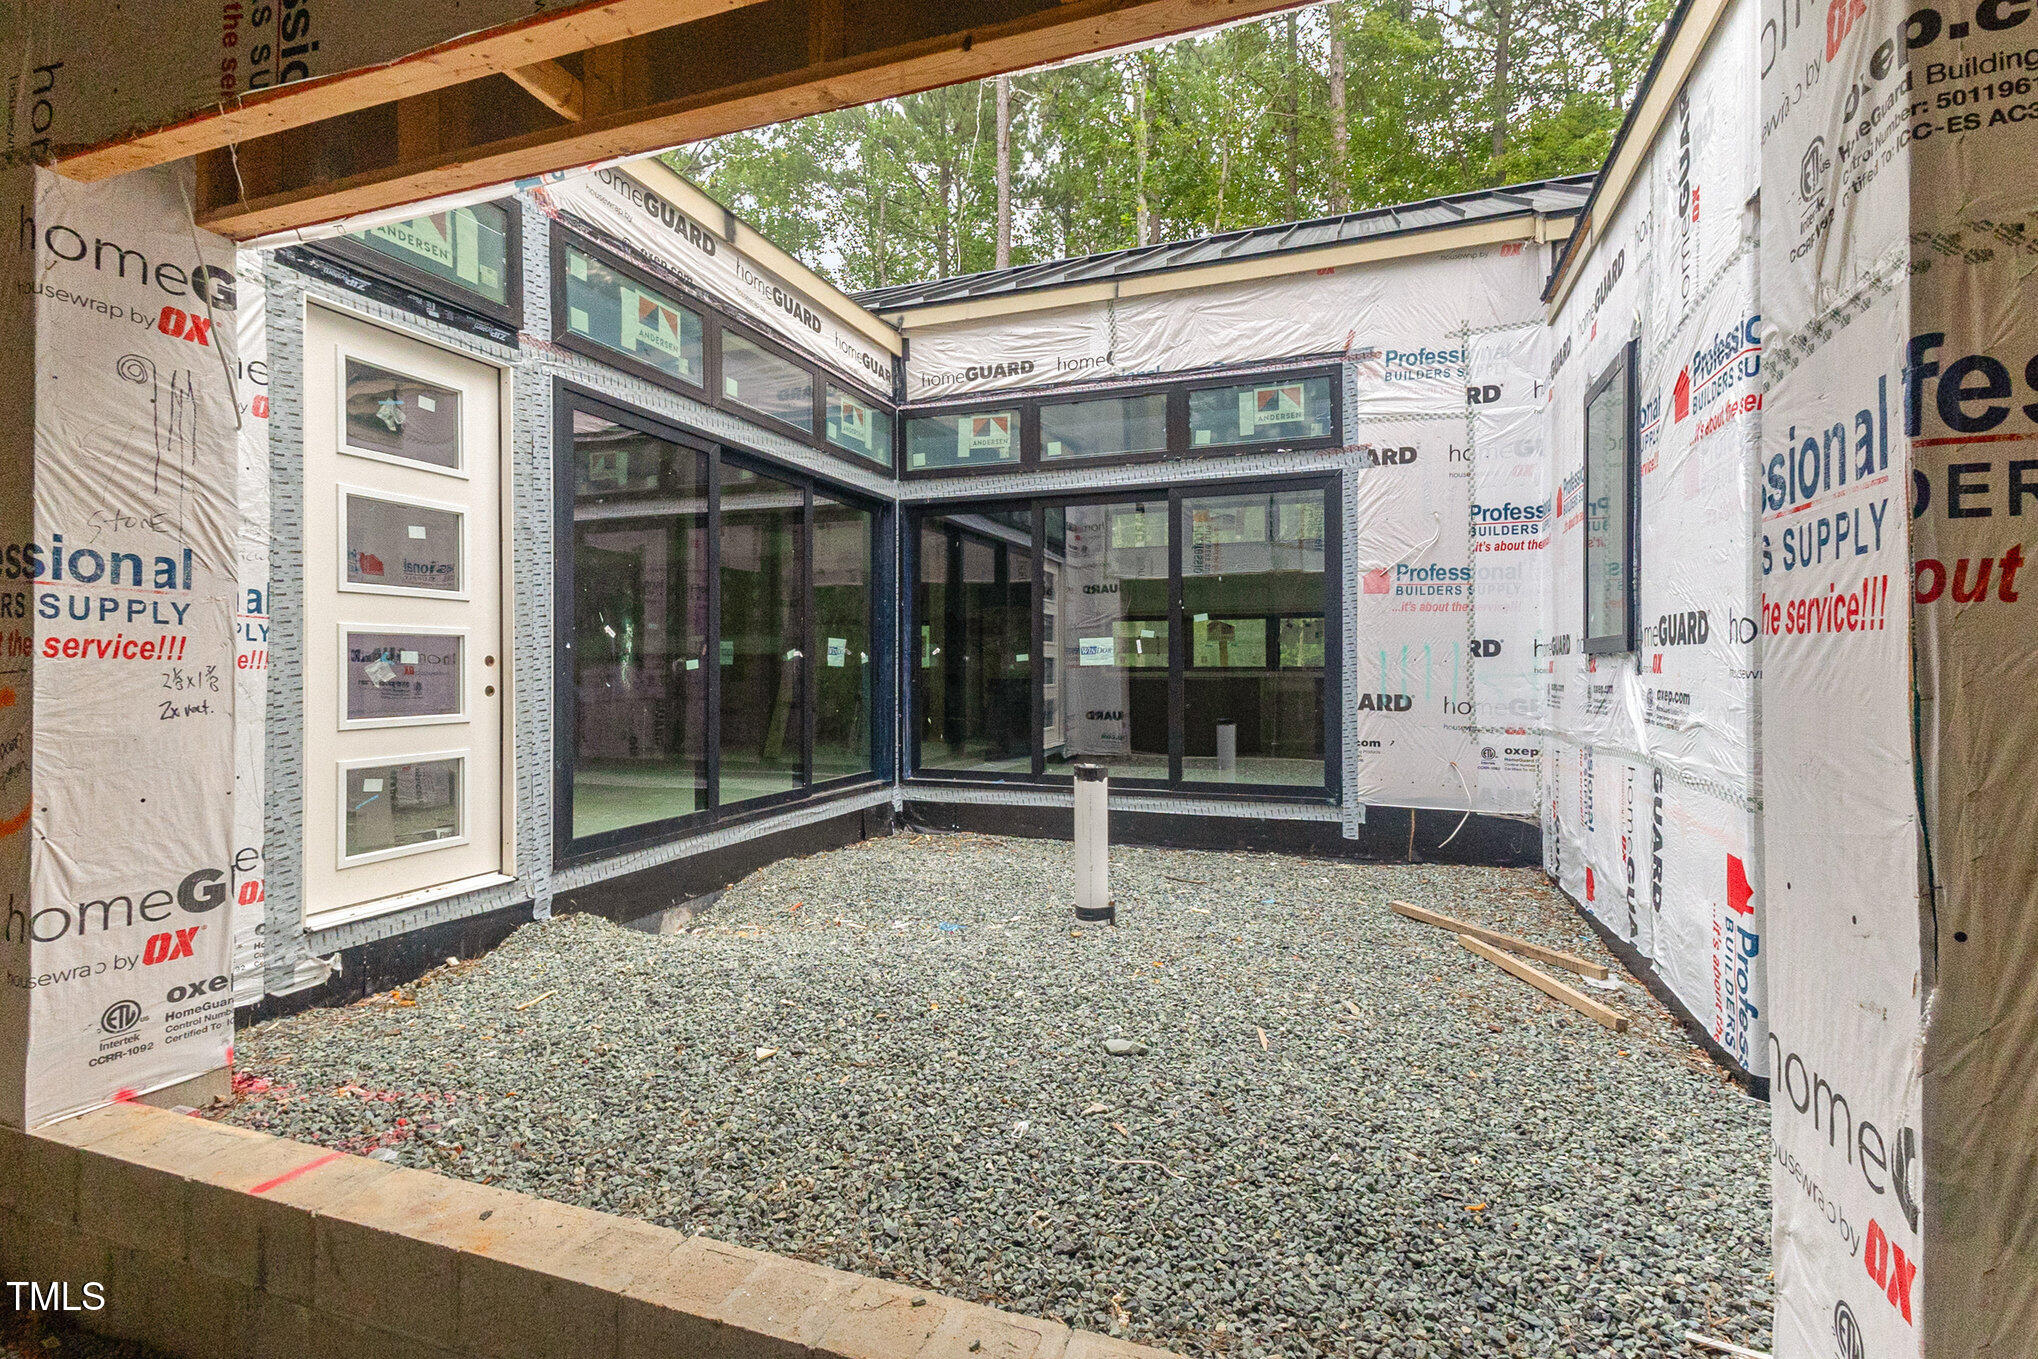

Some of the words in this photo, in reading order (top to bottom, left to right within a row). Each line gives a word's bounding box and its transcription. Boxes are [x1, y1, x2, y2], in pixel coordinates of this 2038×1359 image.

[1926, 48, 2038, 85] Building
[1937, 77, 2038, 110] 501196
[376, 224, 449, 261] ANDERSEN
[1500, 242, 1522, 258] OX
[735, 256, 822, 334] homeGUARD
[130, 308, 155, 329] by
[157, 305, 211, 347] OX
[638, 329, 679, 352] ANDERSEN
[921, 359, 1035, 388] homeGUARD
[1385, 368, 1451, 382] BUILDERS
[1257, 411, 1302, 423] ANDERSEN
[972, 438, 1008, 447] ANDERSEN
[1762, 373, 1889, 515] sional
[1494, 539, 1527, 552] about
[1783, 497, 1889, 573] SUPPLY
[0, 533, 193, 592] ssional
[1395, 585, 1462, 596] BUILDERS
[1785, 574, 1888, 634] service!!!
[38, 592, 192, 626] SUPPLY
[1419, 601, 1449, 612] about
[1451, 601, 1468, 612] the
[42, 633, 188, 661] service!!!
[6, 866, 235, 943] homeG
[114, 954, 140, 972] by
[142, 925, 201, 966] OX
[166, 973, 234, 1004] oxe
[1724, 916, 1736, 1051] BUILDERS
[164, 1024, 209, 1045] Certified
[165, 1017, 203, 1034] Control
[88, 1042, 154, 1068] CCRR-1092
[99, 1033, 141, 1051] Intertek
[1838, 1206, 1861, 1258] by
[1864, 1217, 1917, 1328] OX
